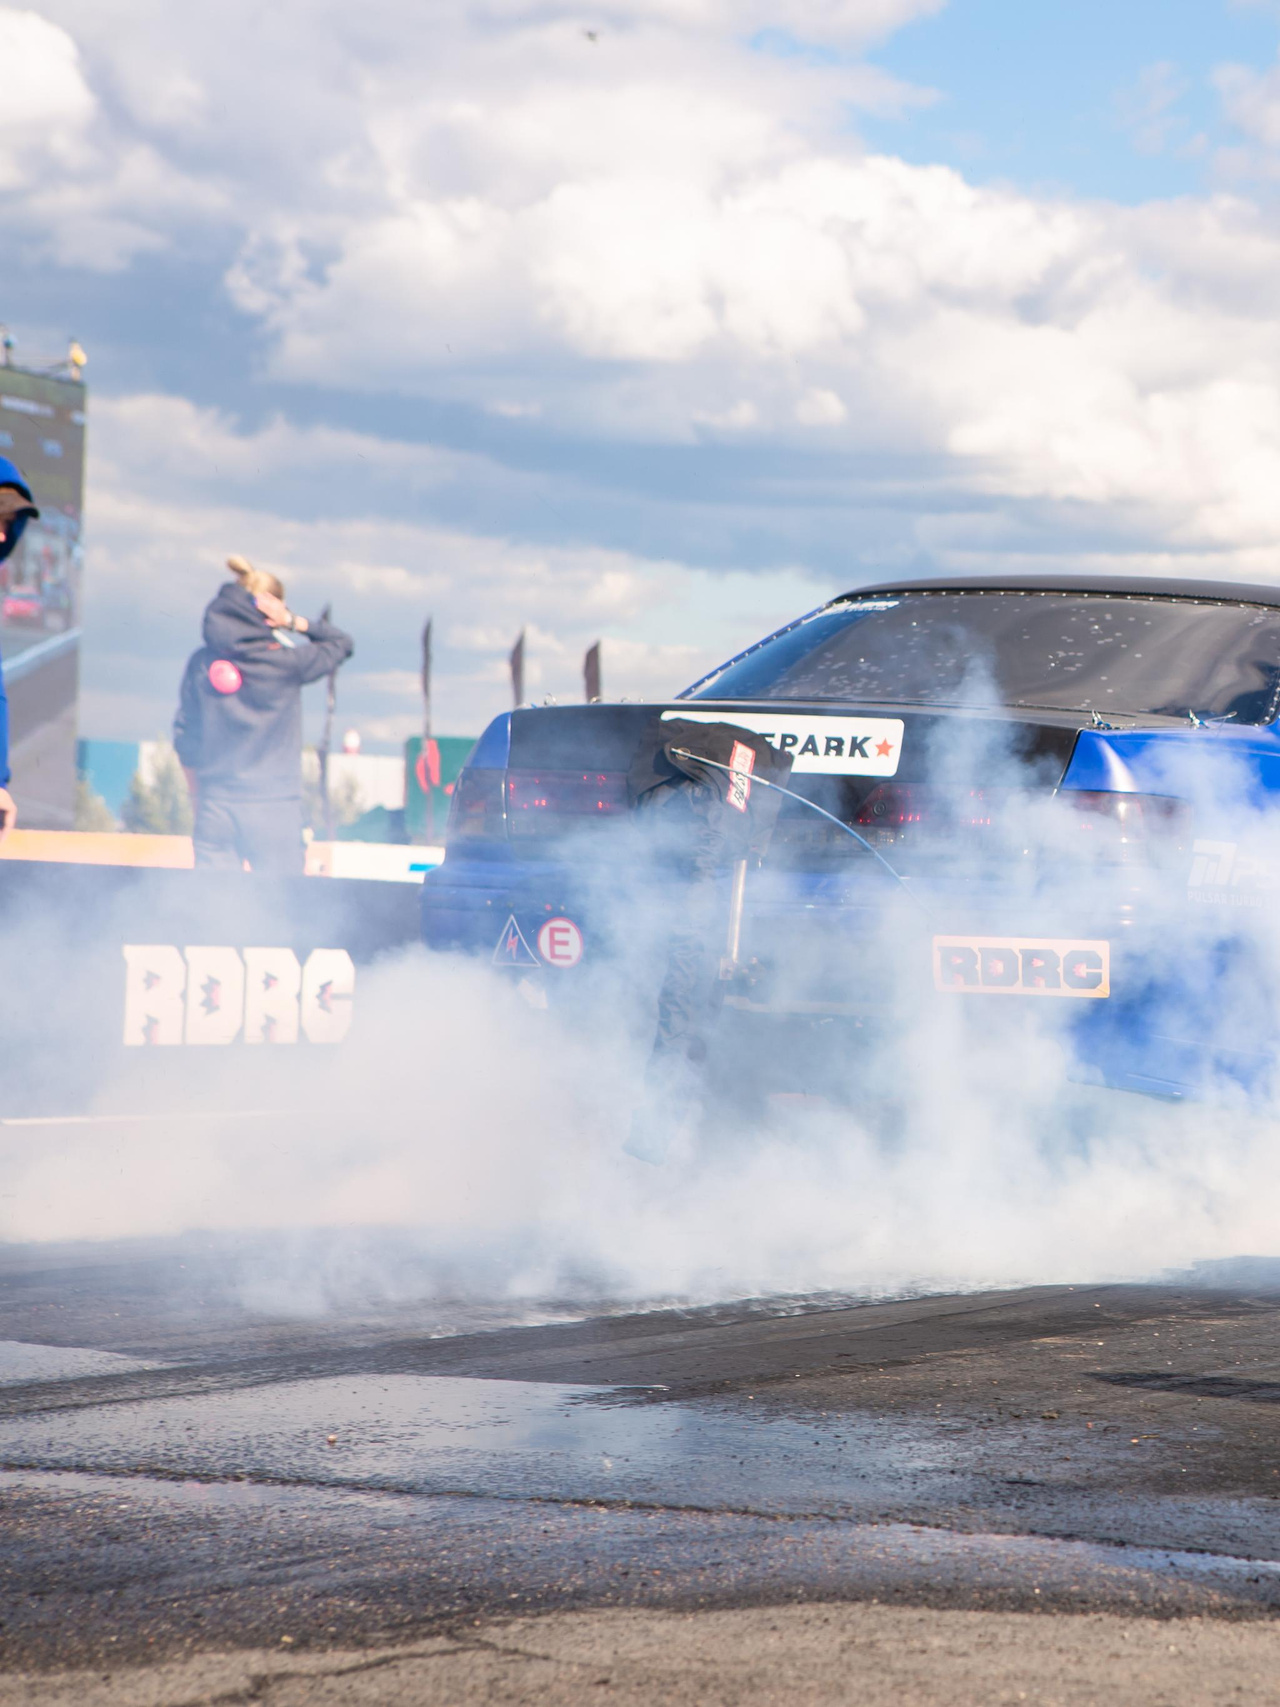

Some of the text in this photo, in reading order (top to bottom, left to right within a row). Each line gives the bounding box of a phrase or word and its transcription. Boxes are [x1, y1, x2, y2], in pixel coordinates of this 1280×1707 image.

[548, 926, 572, 960] E
[937, 946, 1103, 990] RDRC
[122, 944, 355, 1045] RDRC
